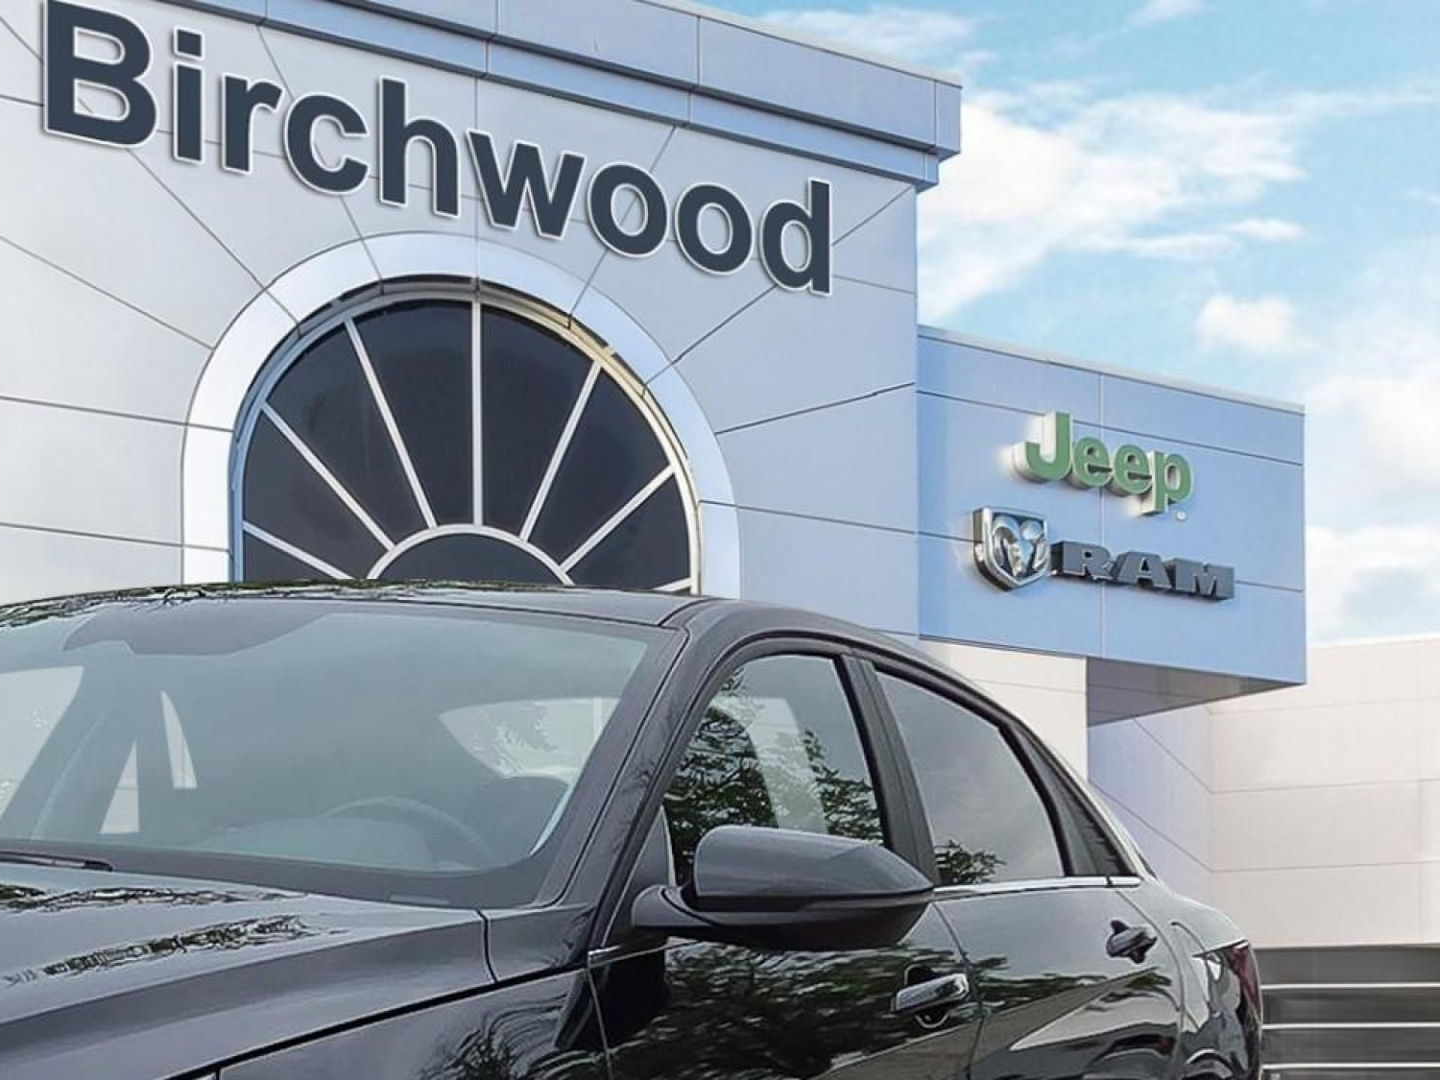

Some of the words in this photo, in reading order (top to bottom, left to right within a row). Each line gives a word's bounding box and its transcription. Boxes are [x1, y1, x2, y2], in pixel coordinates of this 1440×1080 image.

[45, 0, 832, 294] Birchwood
[1015, 411, 1193, 514] Jeep
[1050, 540, 1236, 601] RAM
